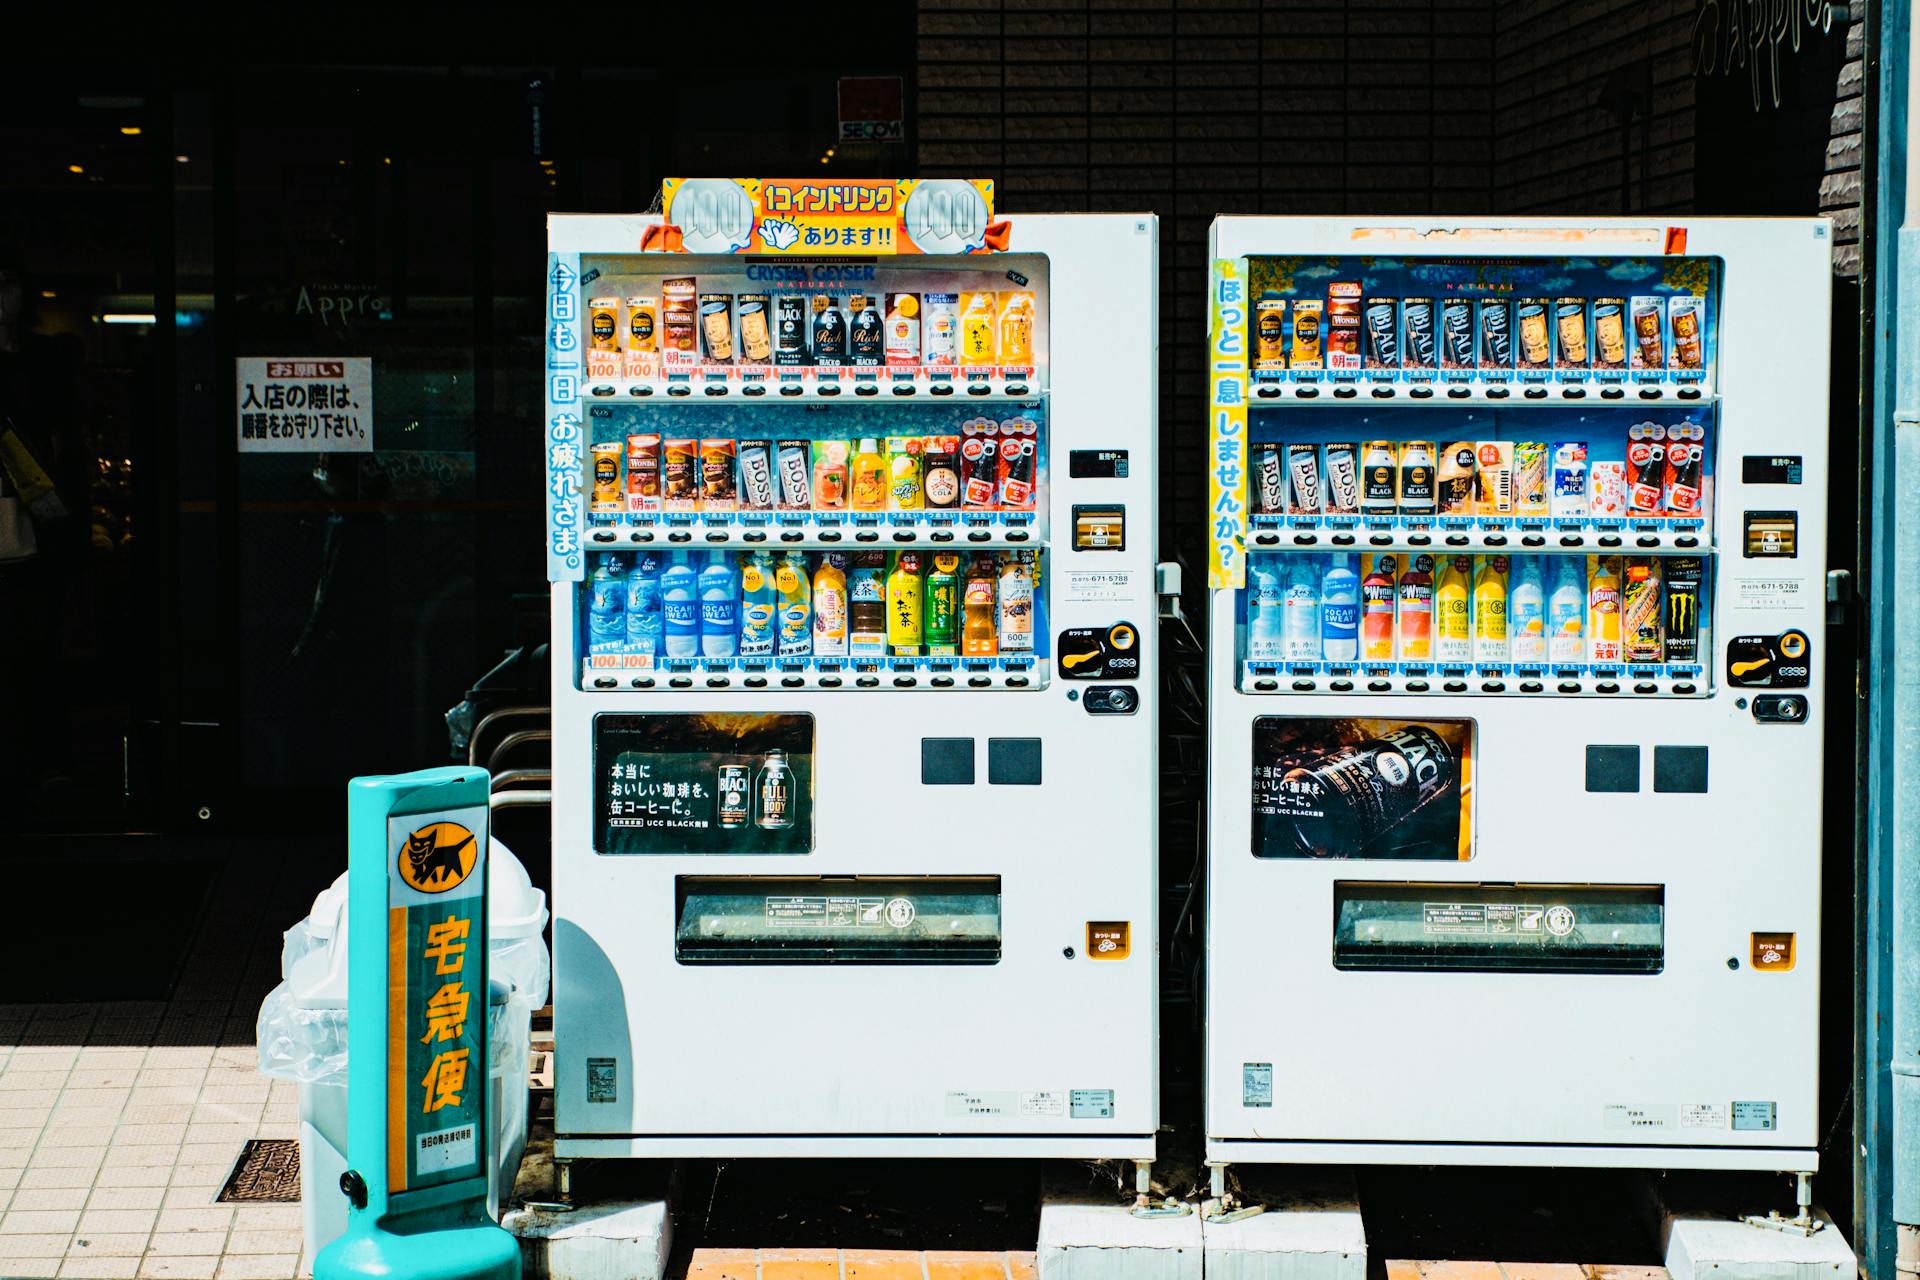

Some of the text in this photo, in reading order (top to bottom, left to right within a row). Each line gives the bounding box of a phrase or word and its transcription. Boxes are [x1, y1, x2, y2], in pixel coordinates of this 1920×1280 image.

[843, 122, 899, 138] SECOM
[764, 184, 893, 212] 1コインドリンク
[805, 226, 891, 246] あります!!
[812, 264, 876, 281] GEYSER
[295, 285, 384, 327] Appro
[666, 312, 691, 321] WONDA
[779, 309, 801, 321] BLACK
[1333, 316, 1358, 324] WONDA
[1375, 310, 1397, 364] BLACK
[1413, 312, 1434, 364] BLACK
[1451, 312, 1473, 364] BLACK
[1490, 311, 1511, 364] BLACK
[270, 363, 342, 377] お願い
[241, 384, 359, 409] 入店の際は、
[241, 413, 365, 439] 順番をお守り下さい。
[631, 458, 656, 467] WONDA
[752, 458, 771, 503] BOSS
[788, 458, 808, 503] BOSS
[1263, 461, 1281, 507] BOSS
[1301, 462, 1319, 507] BOSS
[1339, 461, 1357, 507] BOSS
[1451, 479, 1467, 492] 極
[611, 763, 650, 779] 本当に
[1253, 766, 1282, 778] 本当に
[1380, 730, 1439, 796] BLACK
[611, 782, 710, 799] おいしい珈琲を、
[719, 778, 748, 792] BLACK
[611, 799, 692, 816] 缶コーヒーに。
[420, 914, 470, 1114] 宅急便
